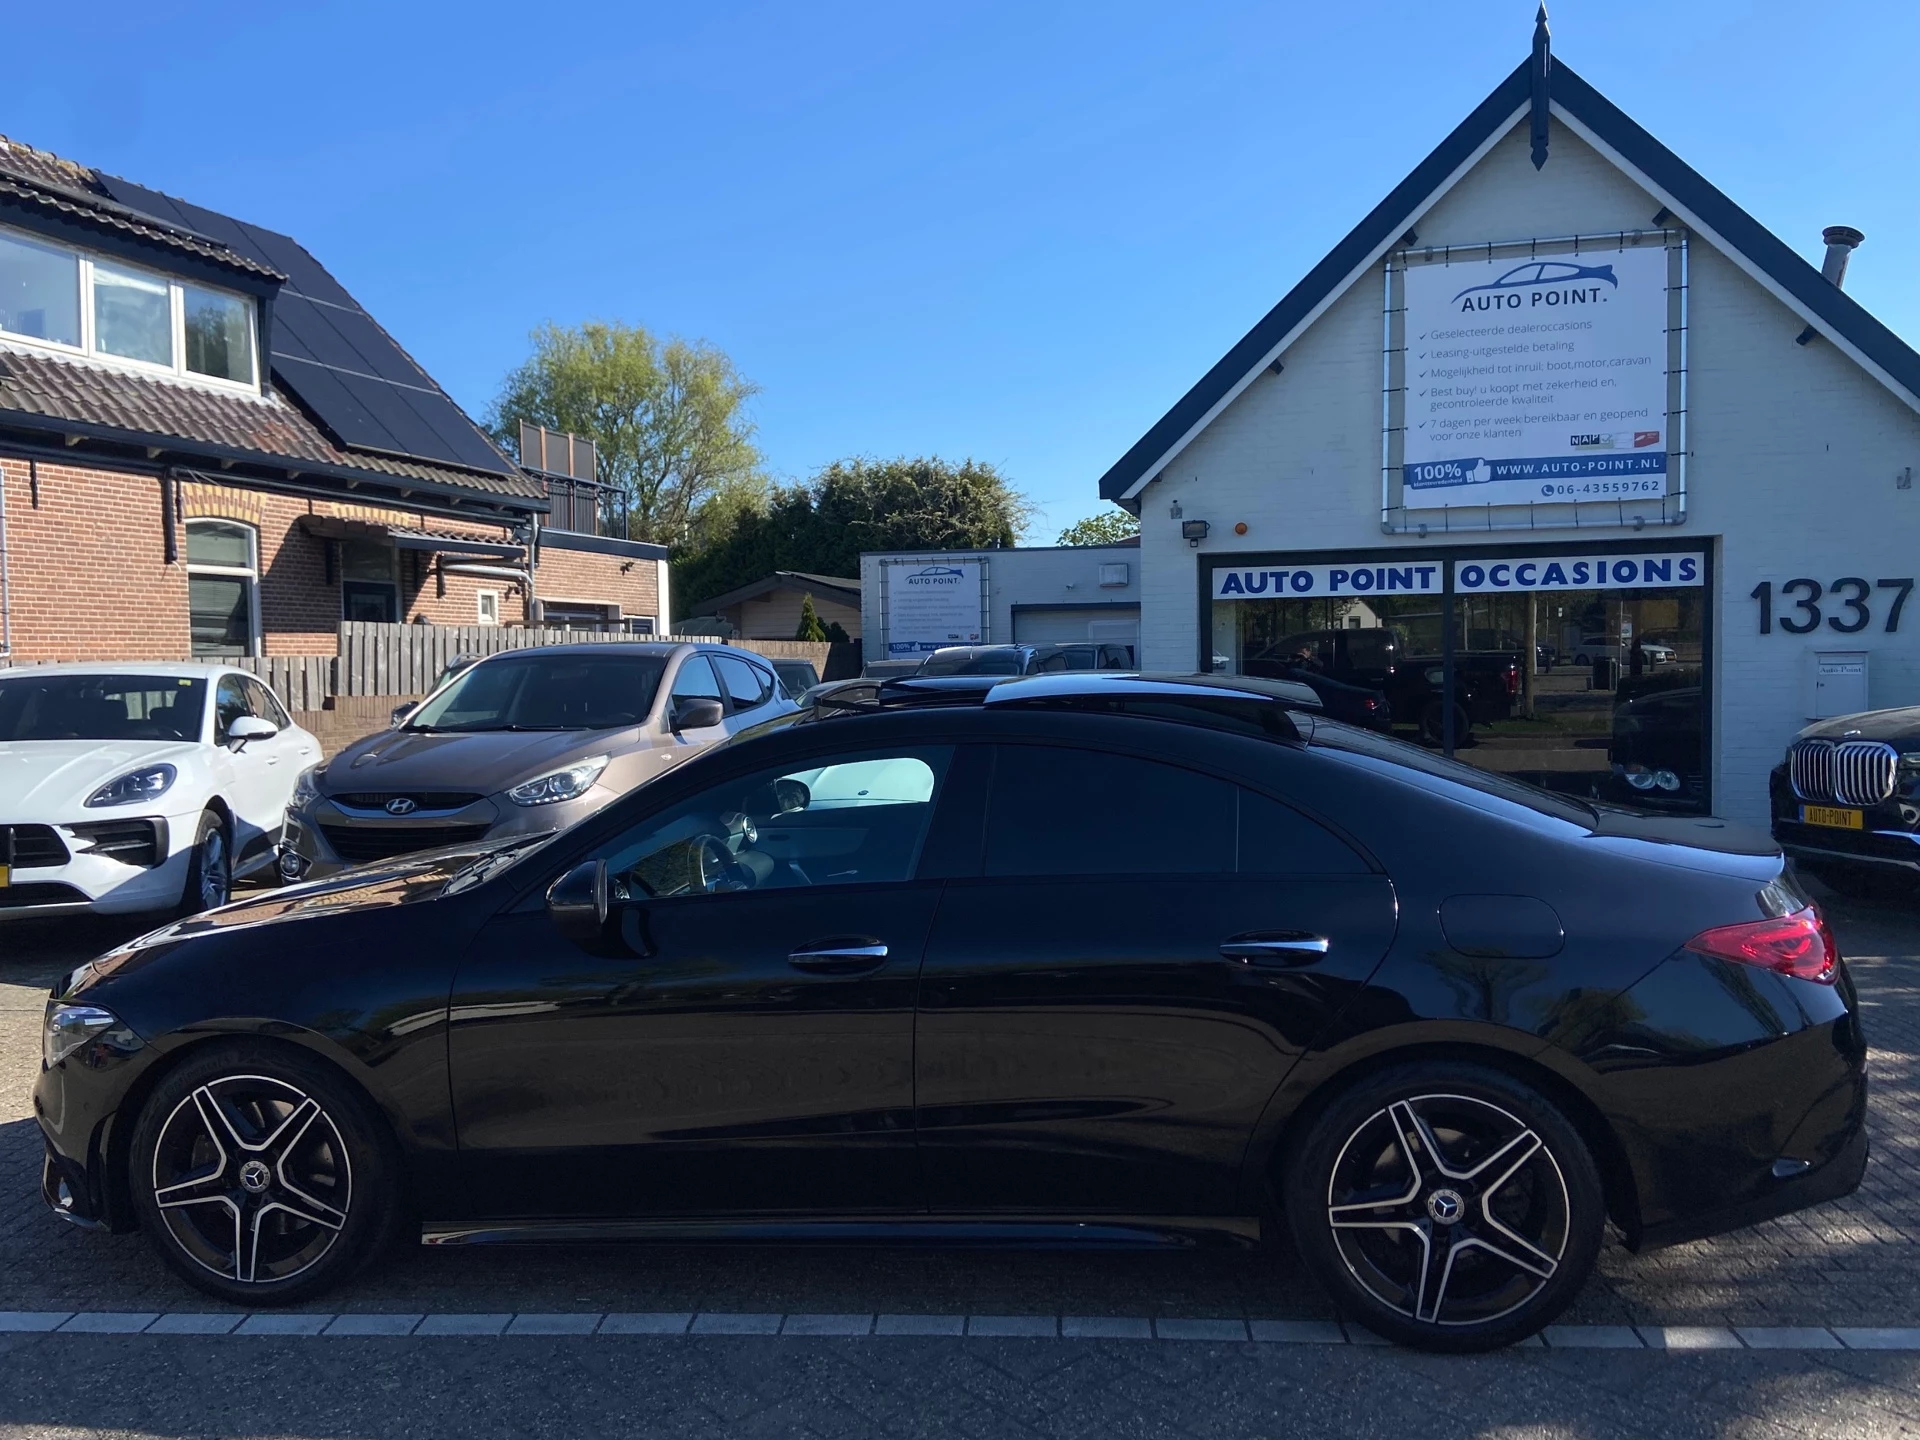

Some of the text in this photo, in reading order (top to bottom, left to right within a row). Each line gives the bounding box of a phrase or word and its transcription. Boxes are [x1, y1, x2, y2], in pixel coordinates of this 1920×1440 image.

[1461, 294, 1522, 312] AUTO
[1431, 320, 1592, 340] Geselecteerde dealeroccasions
[1431, 341, 1574, 359] Leasing-uitgestelde betaling
[1431, 364, 1494, 379] Mogelijkheid
[1497, 365, 1512, 373] tot
[1547, 356, 1651, 371] boot,motor,caravan
[1431, 387, 1452, 397] Best
[1456, 386, 1477, 398] buy!
[1490, 384, 1519, 394] koopt
[1522, 381, 1543, 391] met
[1546, 378, 1597, 389] zekerheid
[1430, 394, 1554, 412] gecontroleerde kwaliteit
[1431, 408, 1648, 430] 7 dagen per week bereikbaar en geopend
[1430, 429, 1522, 441] voor onze klanten
[1571, 434, 1599, 446] NAP
[1414, 463, 1461, 480] 100%
[1497, 459, 1659, 475] WWW.AUTO-POINT.NL
[1557, 481, 1659, 494] 06-43559762
[1220, 557, 1697, 594] AUTO POINT OCCASIONS
[1750, 577, 1914, 634] 1337
[1809, 807, 1852, 826] AUTO-POINT
